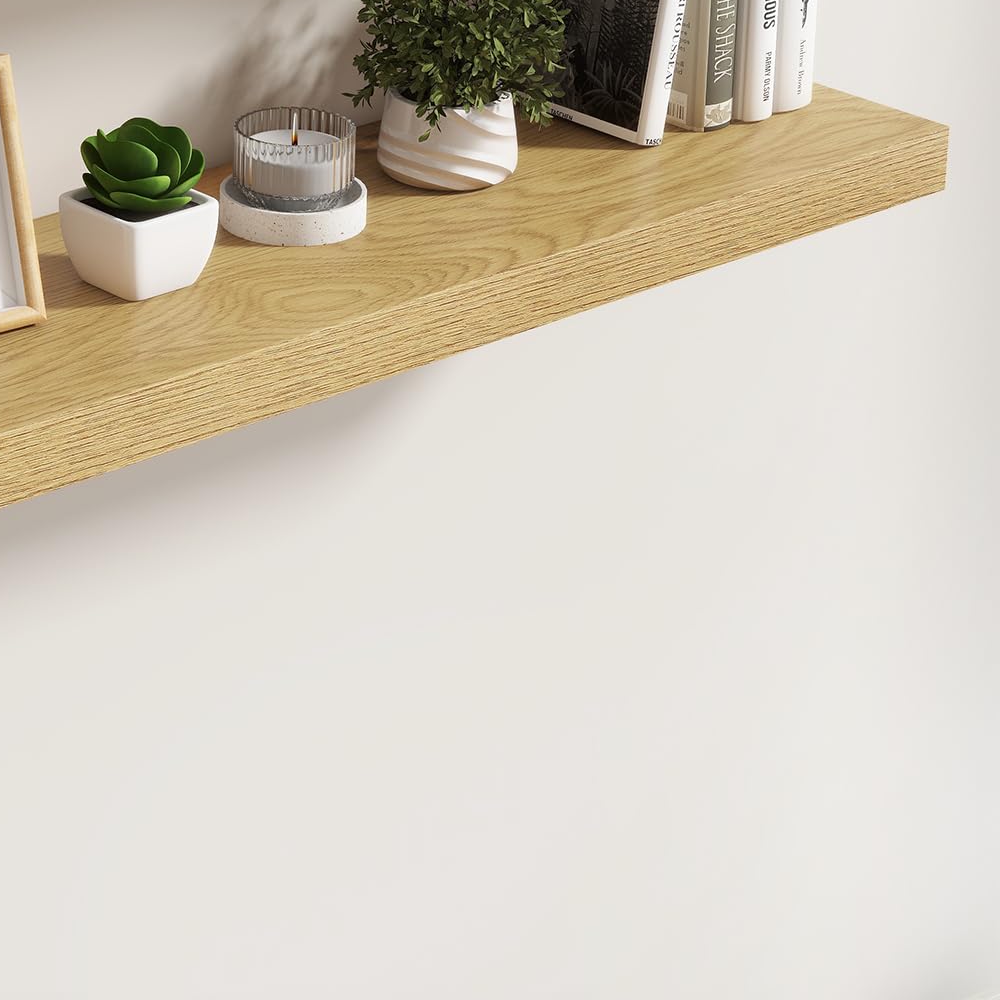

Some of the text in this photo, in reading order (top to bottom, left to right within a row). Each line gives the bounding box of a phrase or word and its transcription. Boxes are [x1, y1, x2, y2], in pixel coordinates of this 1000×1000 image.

[664, 12, 684, 90] ROUSSEAU
[713, 23, 736, 84] SHACK
[762, 50, 773, 102] PARMY OLSON
